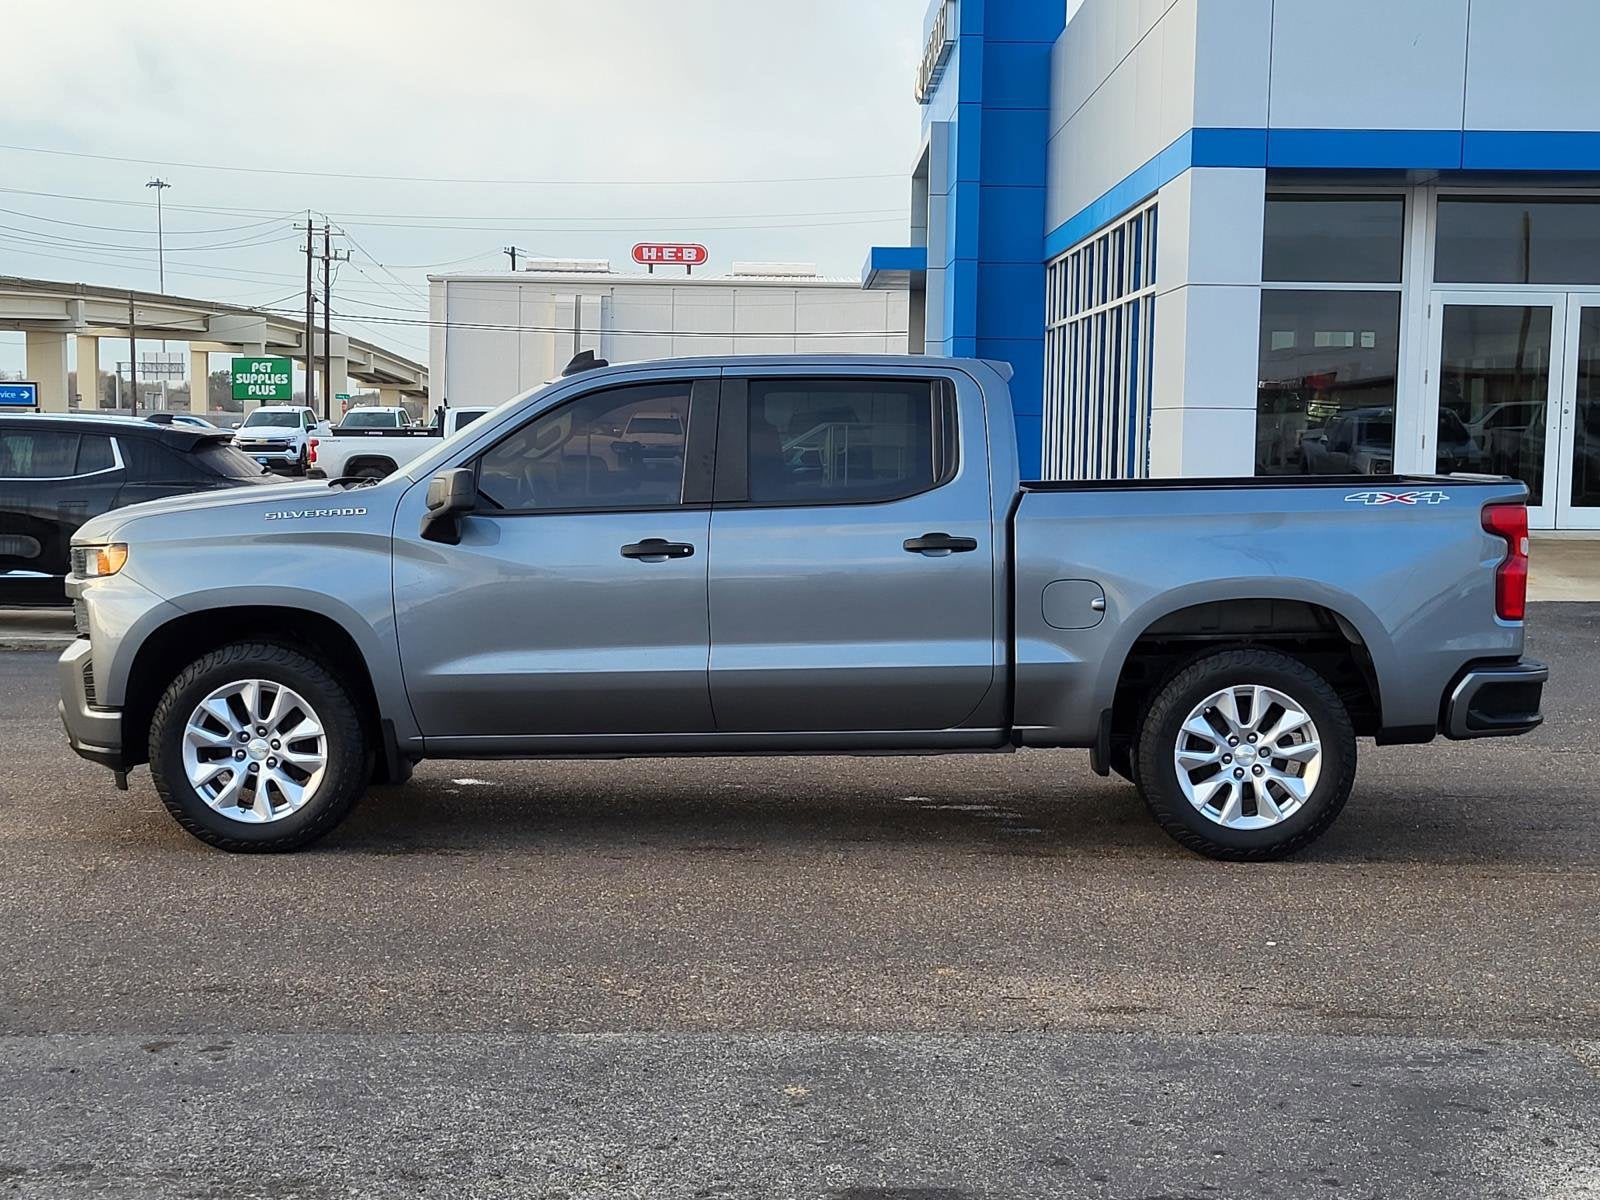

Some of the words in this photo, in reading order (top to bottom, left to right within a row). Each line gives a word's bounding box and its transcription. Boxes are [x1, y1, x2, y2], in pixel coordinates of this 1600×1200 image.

[251, 362, 272, 373] PET
[235, 373, 288, 384] SUPPLIES
[248, 385, 277, 395] PLUS
[264, 507, 367, 520] SILVERADO
